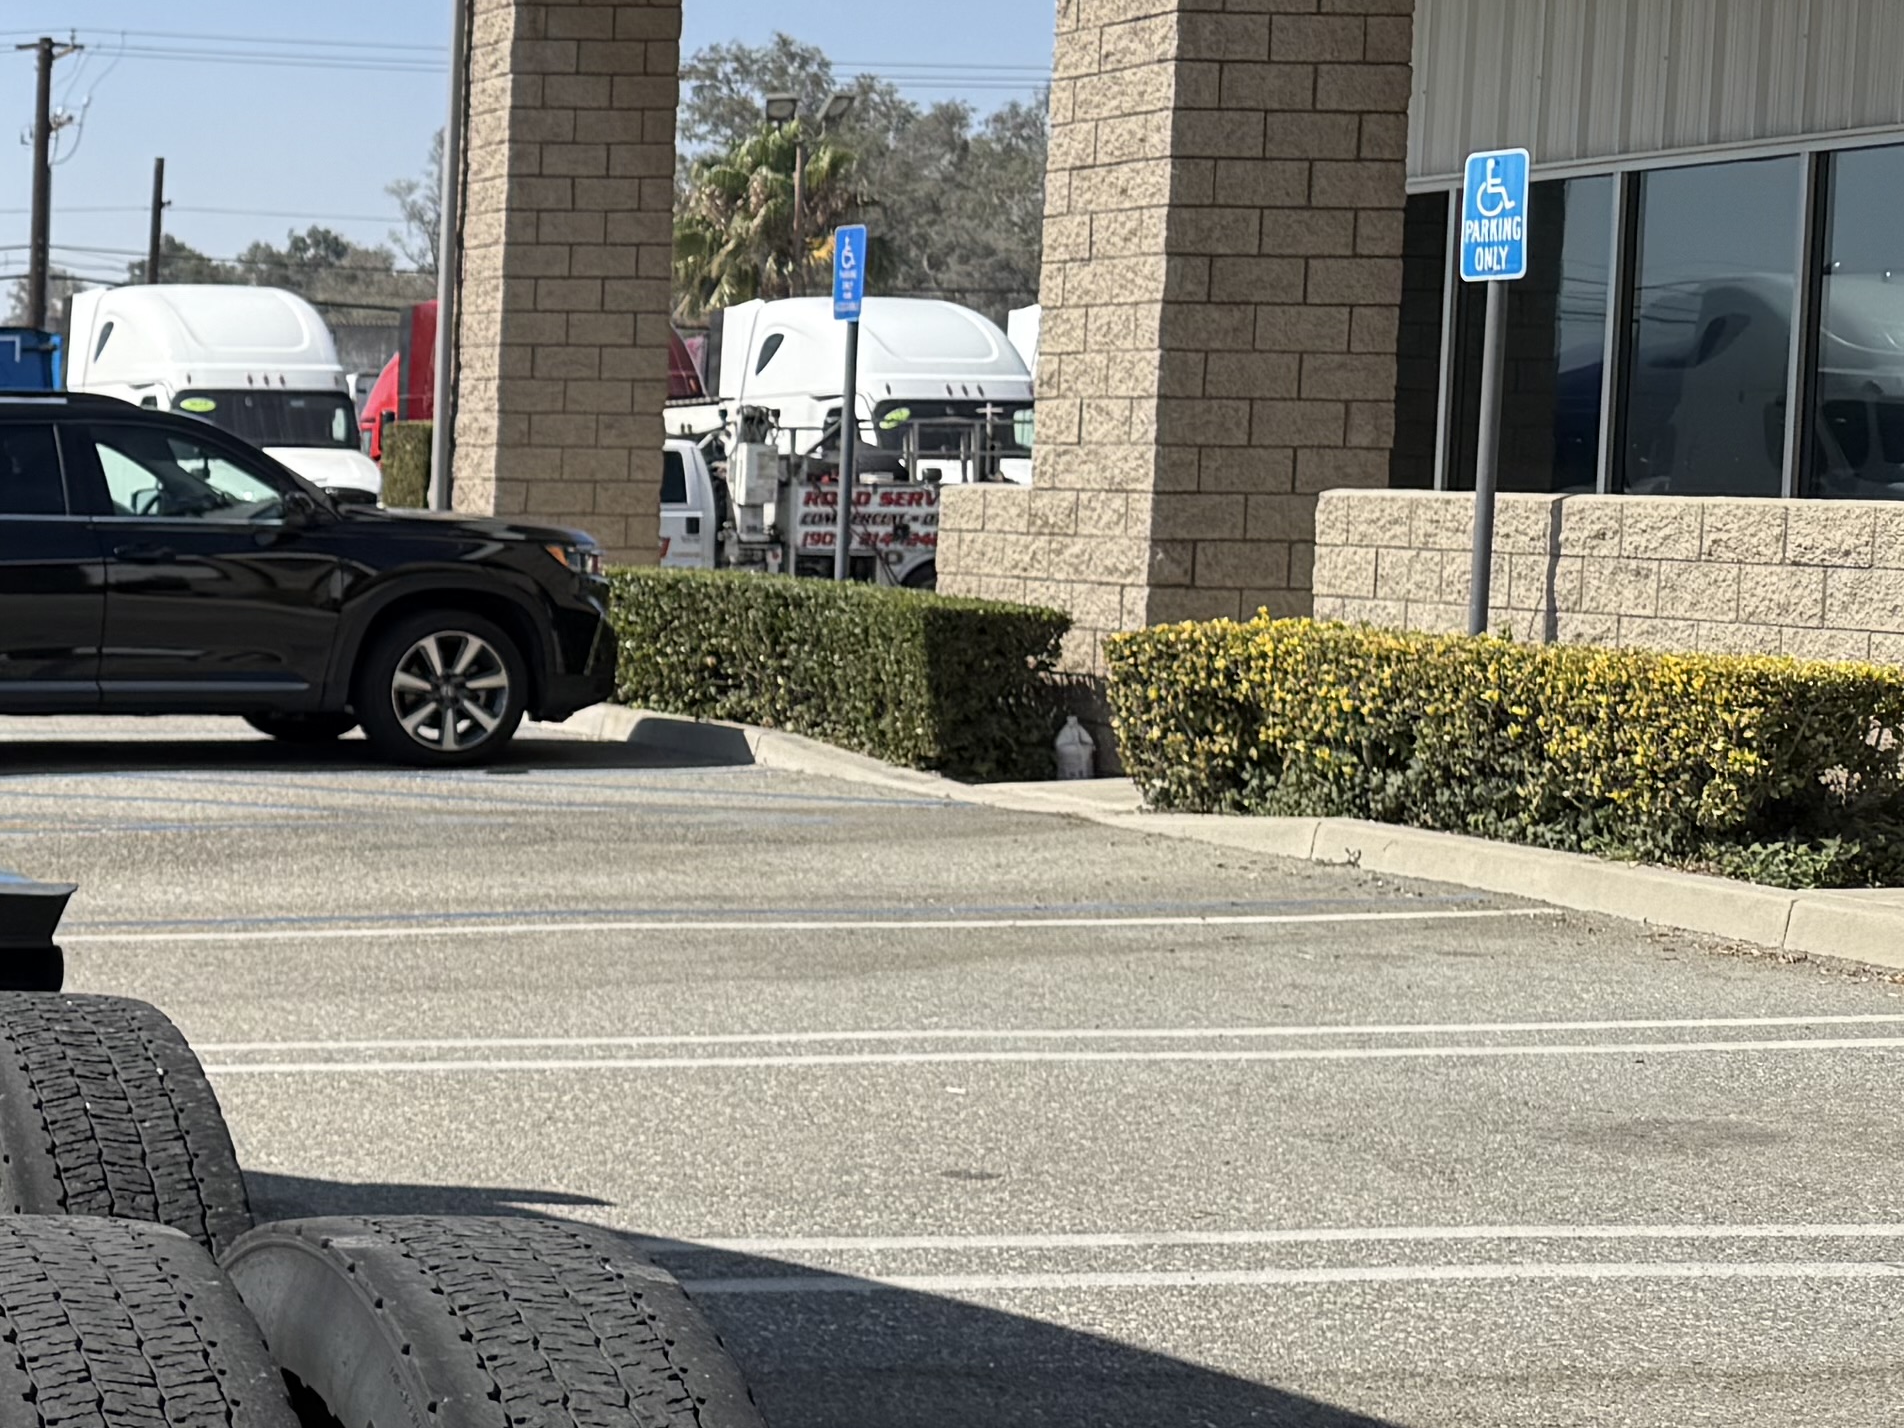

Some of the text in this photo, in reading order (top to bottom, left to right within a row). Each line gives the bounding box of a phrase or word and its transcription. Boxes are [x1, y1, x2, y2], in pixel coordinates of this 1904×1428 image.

[1465, 215, 1522, 243] PARKING
[1474, 245, 1510, 271] ONLY
[803, 491, 872, 507] ROD
